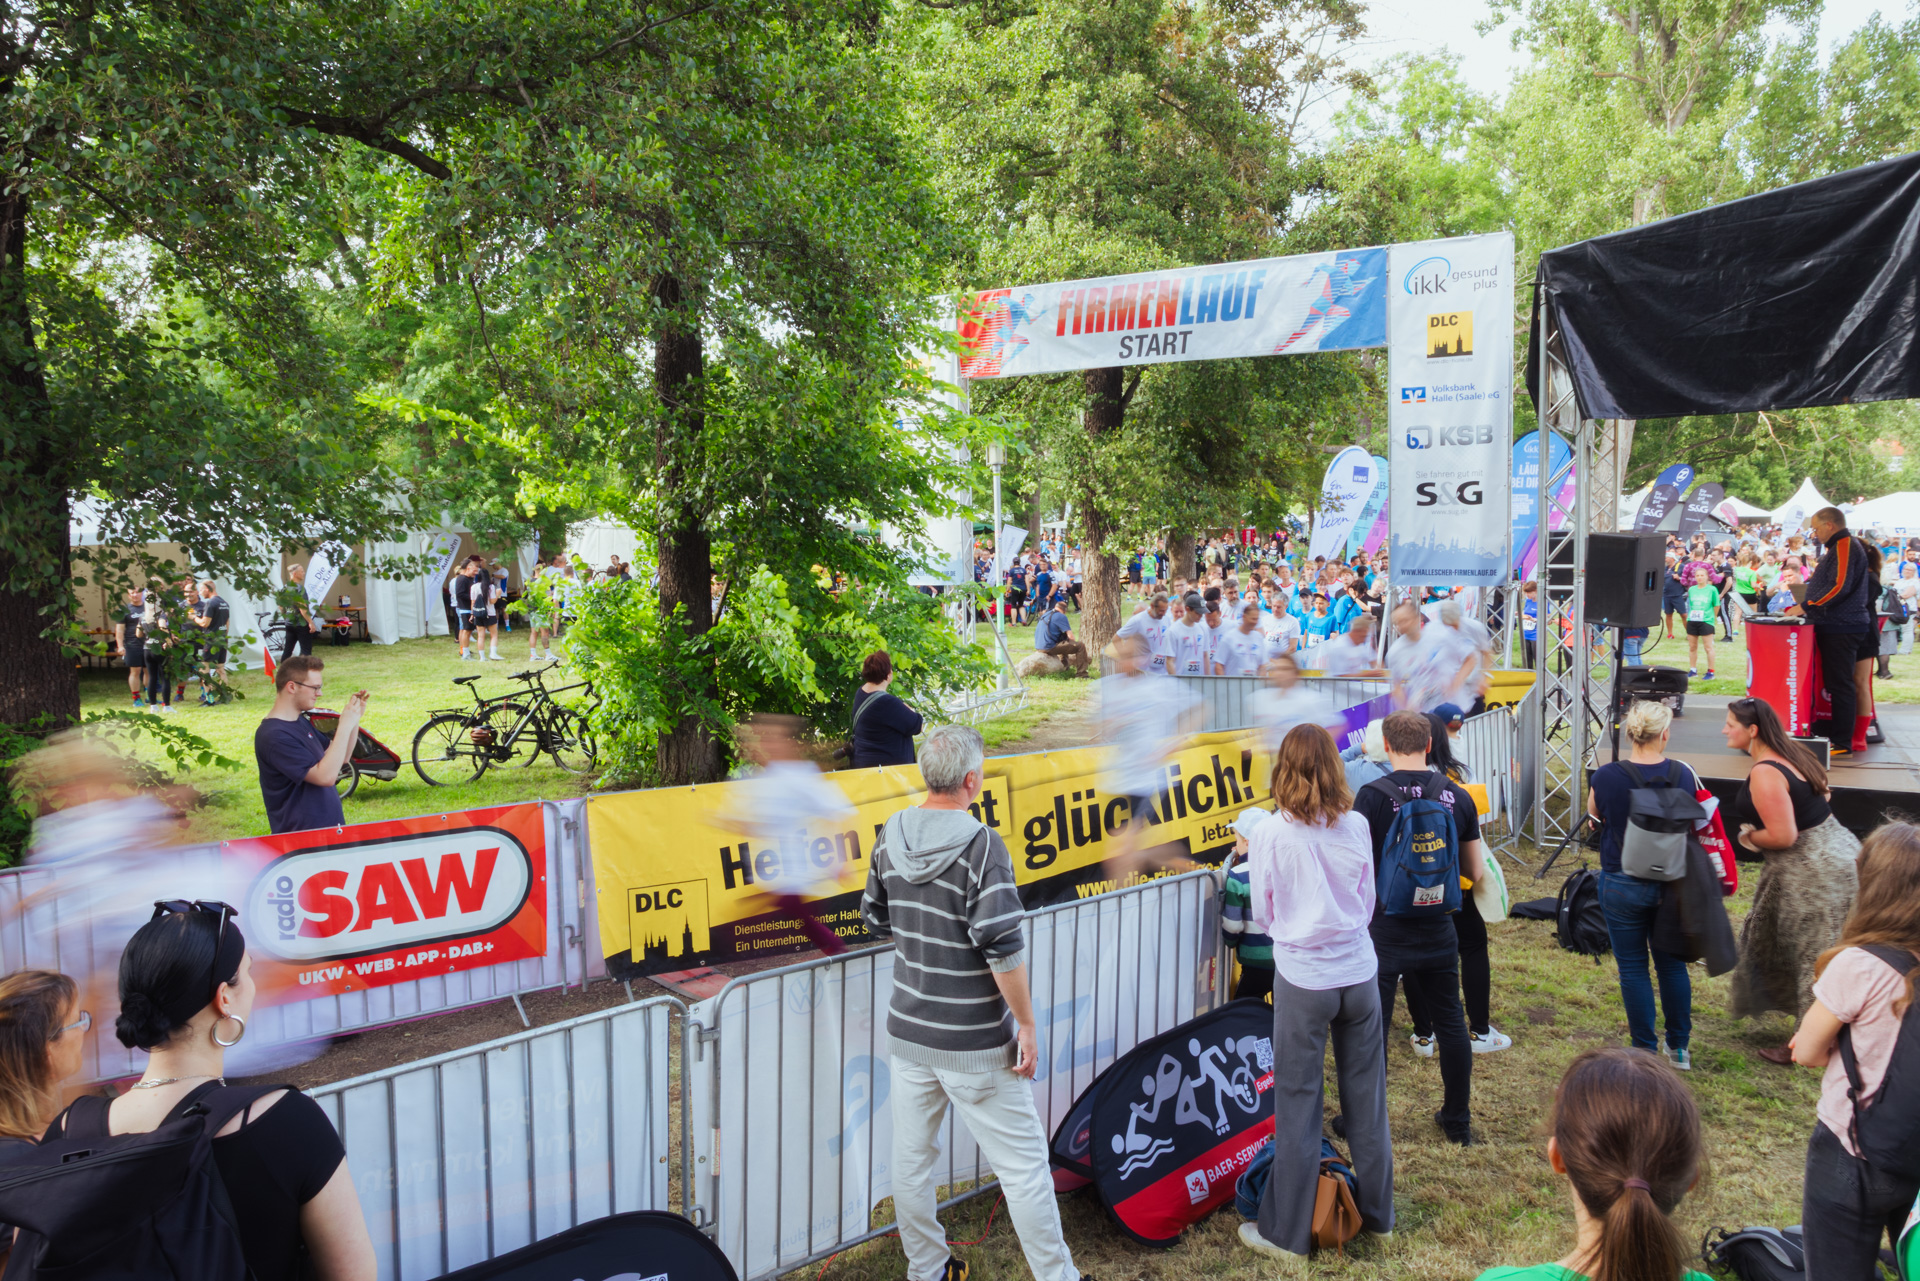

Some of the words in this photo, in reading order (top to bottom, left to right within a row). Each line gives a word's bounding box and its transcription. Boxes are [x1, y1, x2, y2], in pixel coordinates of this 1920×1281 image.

[1414, 273, 1447, 295] ikk
[1452, 265, 1498, 282] gesund
[1473, 278, 1498, 292] plus
[1056, 269, 1266, 337] FIRMENLAUF
[1430, 314, 1458, 328] DLC
[1118, 330, 1193, 358] START
[1432, 382, 1476, 393] Volksbank
[1432, 394, 1453, 402] Halle
[1455, 391, 1486, 402] (Saale)
[1488, 390, 1500, 399] eG
[1440, 424, 1493, 446] KSB
[1415, 470, 1428, 479] Sie
[1430, 470, 1456, 479] fahren
[1457, 470, 1469, 479] gut
[1471, 469, 1483, 477] mit
[1416, 480, 1483, 507] S&G
[1431, 508, 1468, 516] www.sug.de
[1642, 507, 1664, 518] S&G
[1687, 503, 1709, 514] S&G
[1400, 568, 1498, 577] WWW.HALLESCHER-FIRMENLAUF.DE
[1786, 632, 1798, 731] www.radiosaw.de
[297, 846, 501, 939] SAW
[635, 888, 684, 913] DLC
[1419, 891, 1439, 902] 4244
[267, 875, 296, 941] radio
[735, 942, 750, 953] Ein
[834, 924, 860, 938] ADAC
[299, 965, 344, 986] UKW
[355, 957, 395, 976] WEB
[405, 949, 439, 968] APP
[449, 941, 494, 959] DAB+
